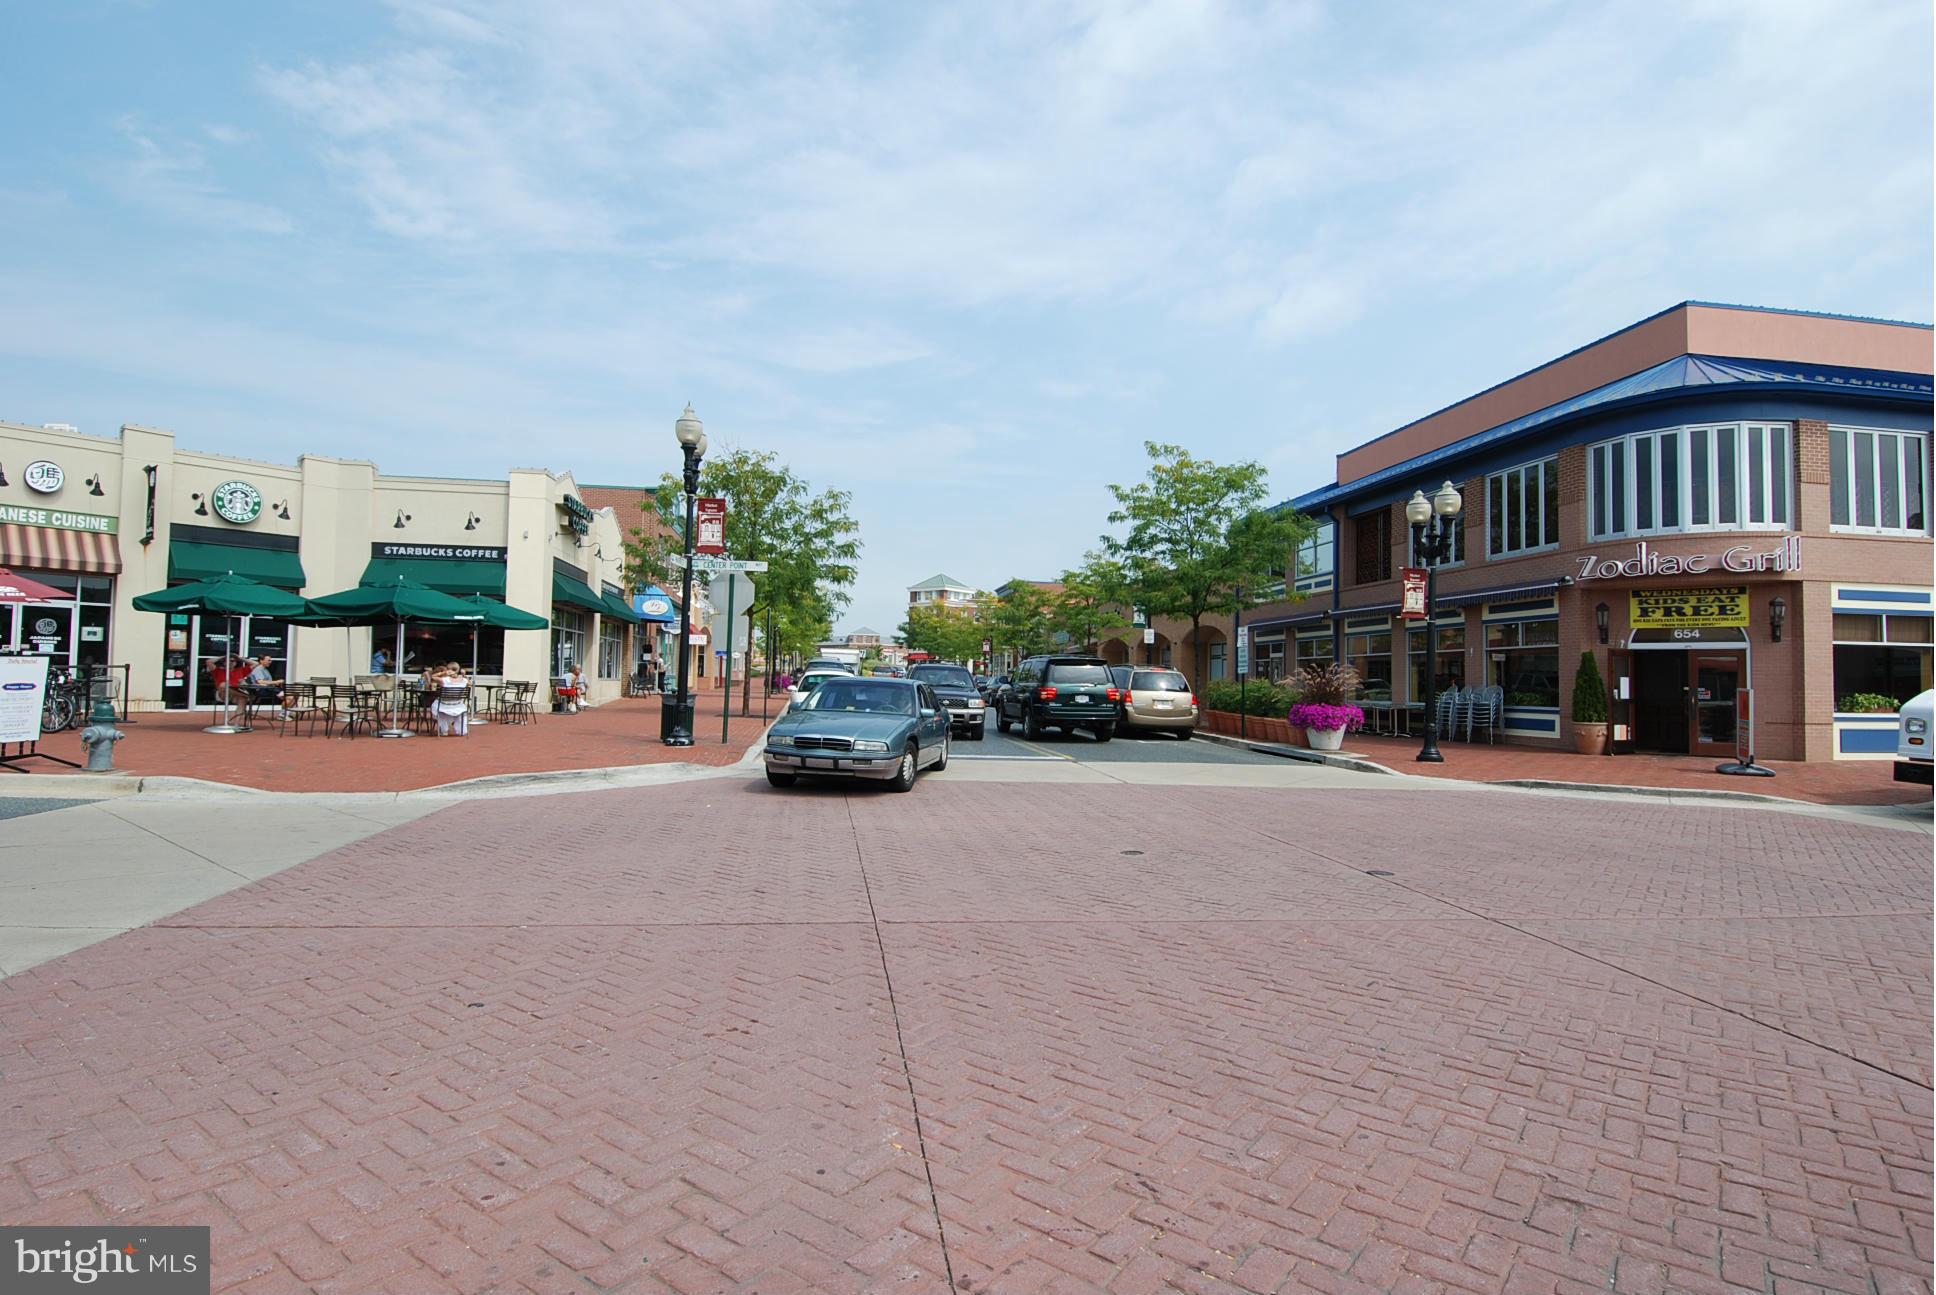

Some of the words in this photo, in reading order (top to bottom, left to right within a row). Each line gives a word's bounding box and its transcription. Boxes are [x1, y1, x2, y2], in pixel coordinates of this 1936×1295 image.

[217, 482, 261, 502] STARBUCKS
[221, 507, 254, 521] COFFEE
[52, 512, 109, 531] CUISINE
[384, 546, 454, 556] STARBUCKS
[455, 548, 498, 558] COFFEE
[1576, 541, 1710, 580] Zodiac
[1721, 535, 1801, 572] Grill
[1639, 587, 1739, 597] WEDNESDAYS
[1637, 597, 1690, 606] KIDS
[1696, 596, 1740, 604] EAT
[1637, 604, 1742, 618] FREE
[1674, 629, 1700, 638] 654
